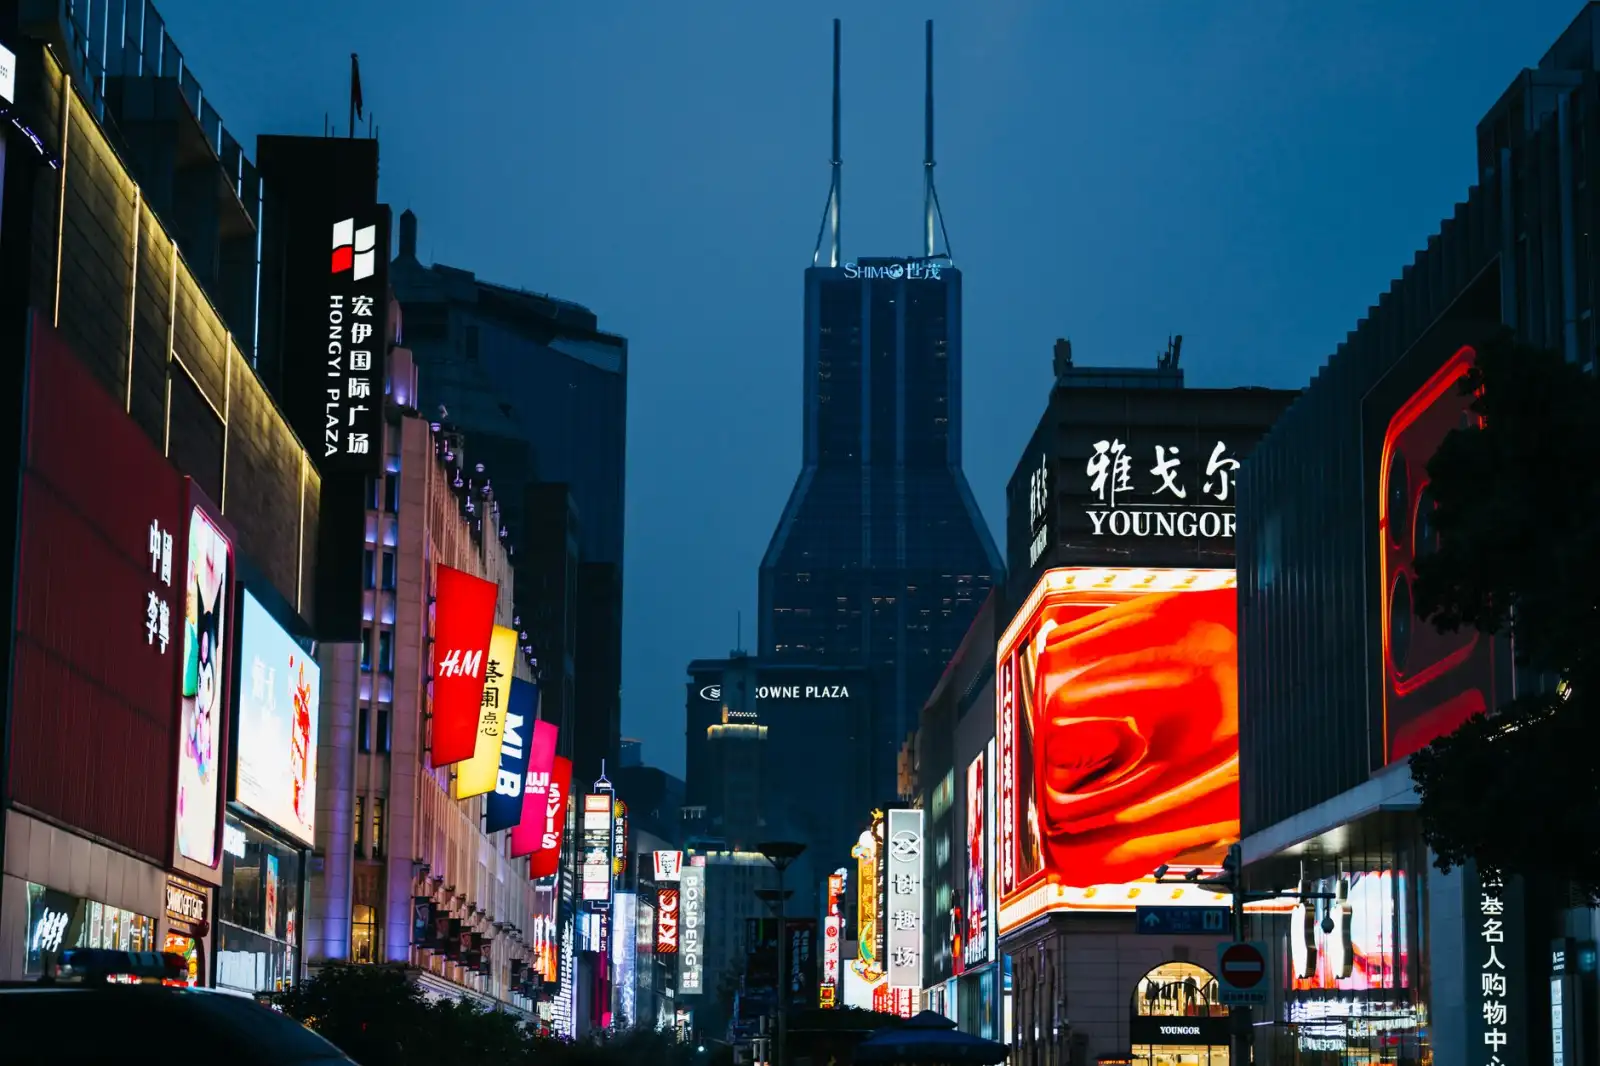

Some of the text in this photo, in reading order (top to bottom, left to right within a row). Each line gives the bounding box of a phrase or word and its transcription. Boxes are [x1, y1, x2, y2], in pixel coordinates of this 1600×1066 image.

[905, 262, 941, 280] 世茂
[325, 295, 344, 457] HONGYI PLAZA
[346, 294, 374, 455] 宏伊国际广场
[1086, 437, 1241, 508] 雅戈尔
[440, 650, 482, 678] H&M
[755, 686, 849, 699] OWNE PLAZA
[497, 711, 524, 798] MLB
[525, 772, 549, 787] UJI
[658, 894, 678, 947] KFC
[685, 876, 698, 966] BOSIDENG
[1160, 1026, 1200, 1035] YOUNGOR
